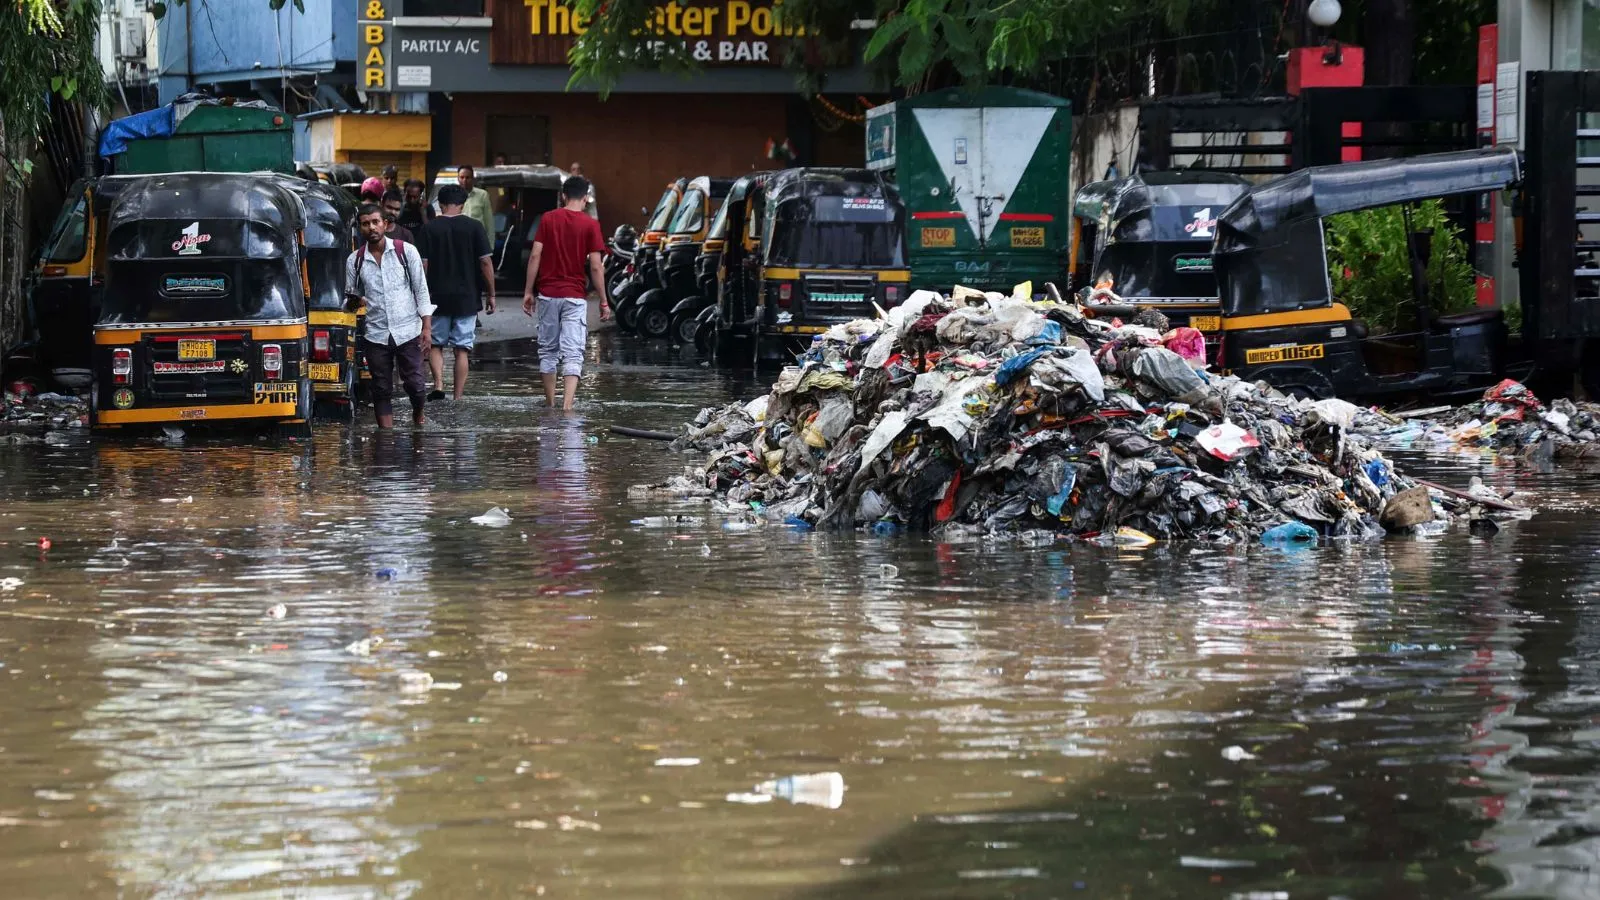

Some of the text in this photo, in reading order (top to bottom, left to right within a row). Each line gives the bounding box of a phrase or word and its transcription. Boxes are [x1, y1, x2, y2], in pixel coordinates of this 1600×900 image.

[524, 0, 591, 35] The
[365, 0, 385, 87] & BAR
[401, 38, 480, 54] PARTLY A/C
[692, 40, 713, 61] &
[718, 41, 769, 61] BAR
[186, 350, 208, 358] F7108
[1280, 345, 1321, 360] 1054
